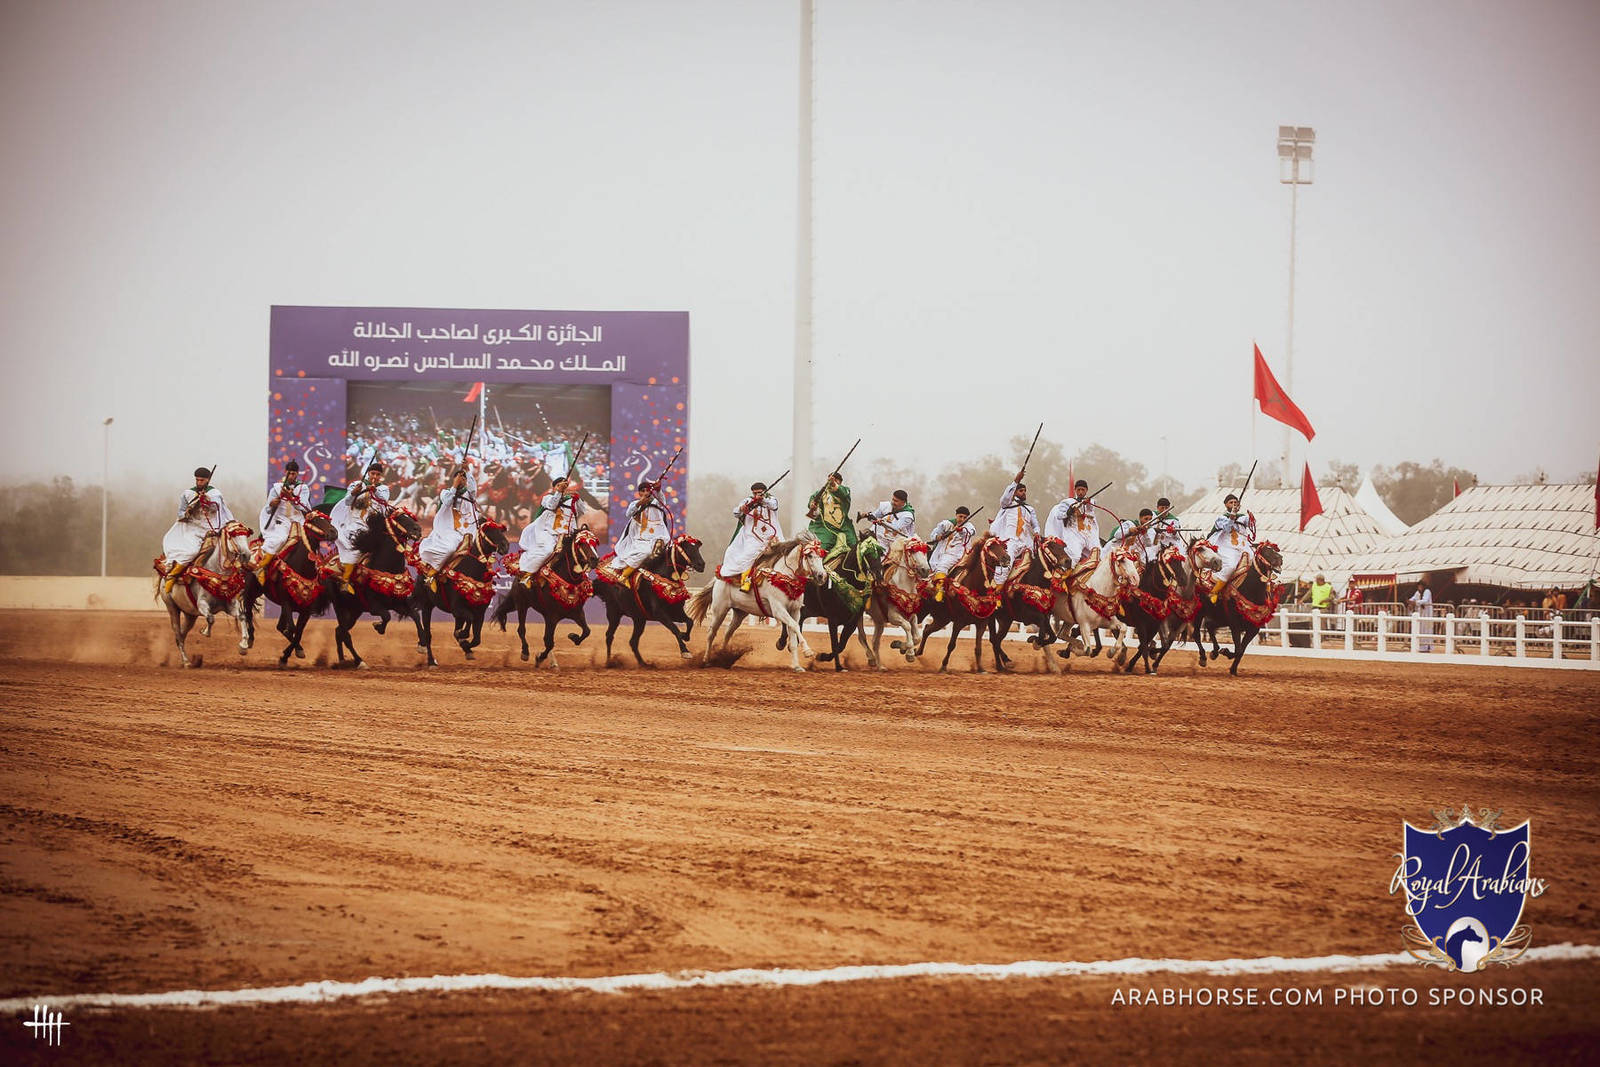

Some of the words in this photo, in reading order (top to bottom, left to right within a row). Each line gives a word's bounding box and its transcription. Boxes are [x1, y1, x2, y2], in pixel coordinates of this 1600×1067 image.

[353, 320, 413, 341] الجلالة
[416, 322, 479, 343] لصاحب
[482, 322, 542, 345] الكبرى
[546, 323, 603, 346] الجائزة
[328, 348, 360, 368] الله
[364, 350, 410, 372] نصره
[413, 352, 492, 373] السادس
[495, 356, 555, 372] محمد
[558, 354, 627, 373] الملك
